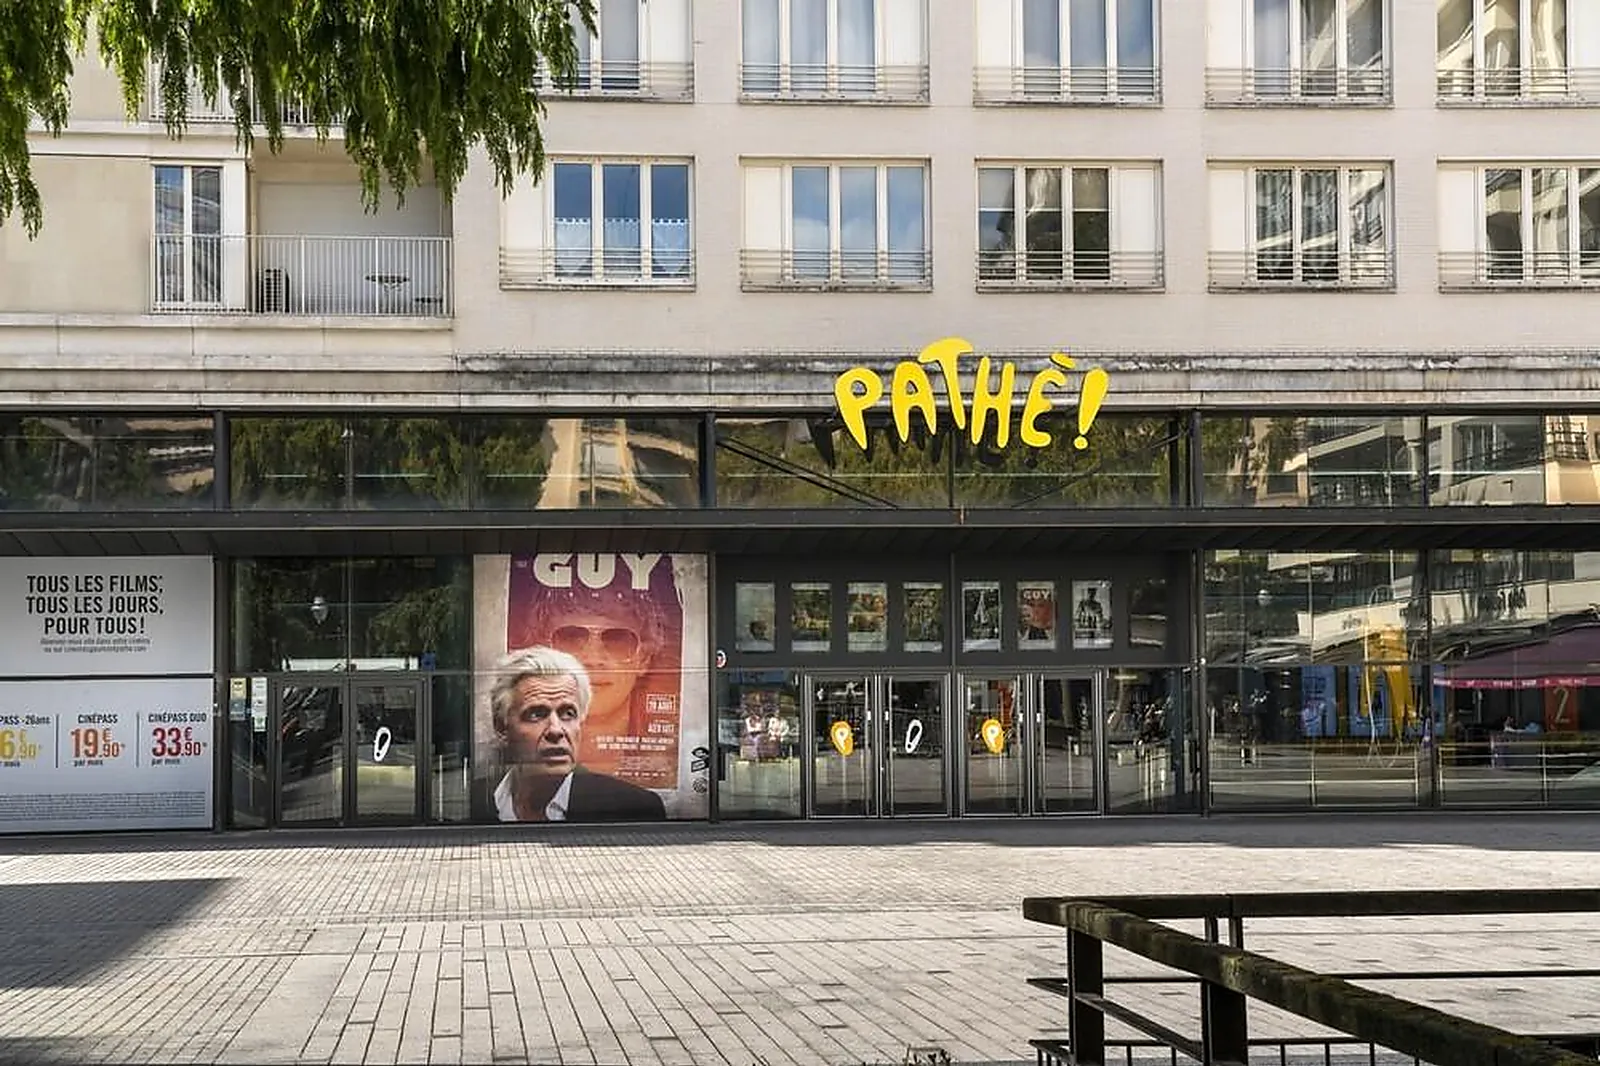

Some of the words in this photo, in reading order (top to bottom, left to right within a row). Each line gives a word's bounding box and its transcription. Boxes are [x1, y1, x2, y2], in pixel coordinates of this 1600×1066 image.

[533, 554, 662, 589] GUY
[27, 575, 69, 593] TOUS
[75, 575, 103, 592] LES
[1023, 590, 1050, 599] GUY
[26, 596, 68, 614] TOUS
[75, 596, 103, 613] LES
[44, 617, 89, 634] POUR
